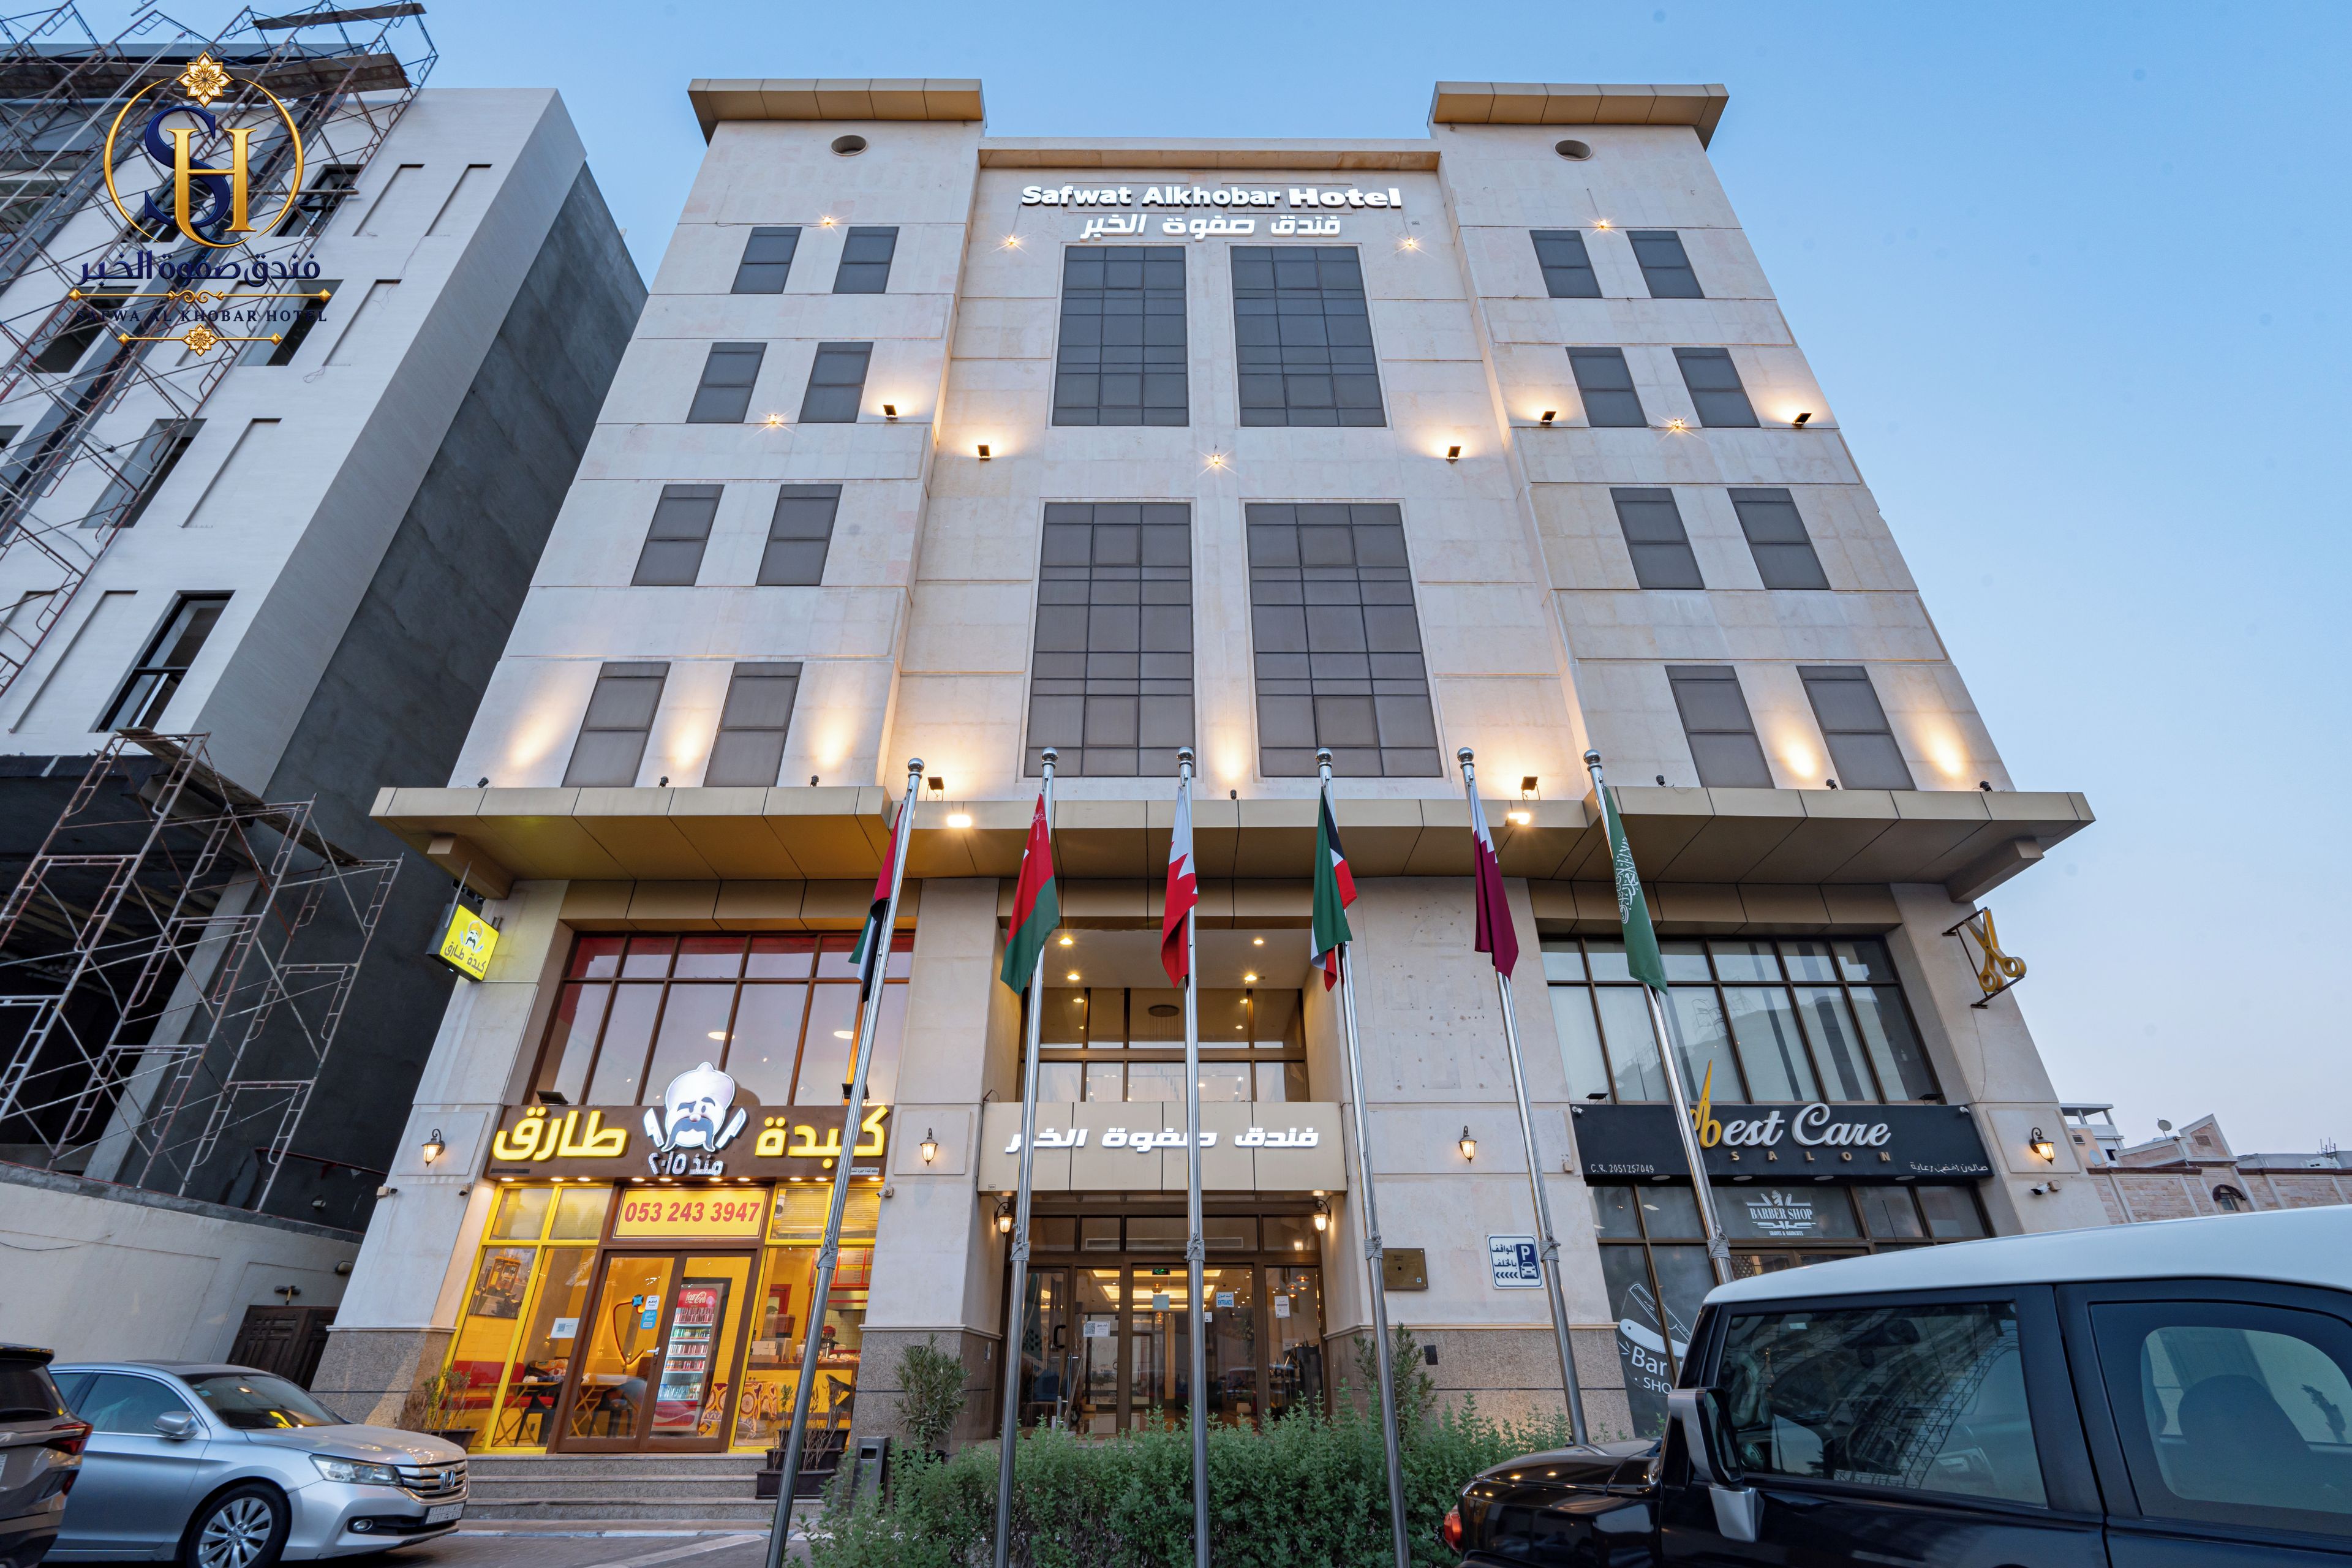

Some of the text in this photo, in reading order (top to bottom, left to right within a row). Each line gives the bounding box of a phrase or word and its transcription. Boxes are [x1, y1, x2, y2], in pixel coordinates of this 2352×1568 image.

[1022, 186, 1402, 208] Safwat Alkhobar Hotel
[1080, 214, 1341, 242] فندق صفوة الخبر
[444, 941, 487, 974] كبدة طارق
[1792, 1102, 1891, 1146] Care
[493, 1106, 889, 1169] كبدة طارق
[1005, 1128, 1319, 1155] فندق صفوة الخر
[689, 1153, 725, 1176] منذ
[1730, 1151, 1892, 1162] SALON
[625, 1202, 761, 1222] 053 243 3947
[1749, 1208, 1813, 1220] BARBER SHOP
[1492, 1244, 1516, 1255] المواقف
[1520, 1245, 1531, 1261] P
[1494, 1259, 1518, 1270] بالخلف
[1631, 1346, 1667, 1377] Bar
[1643, 1376, 1673, 1394] SHO
